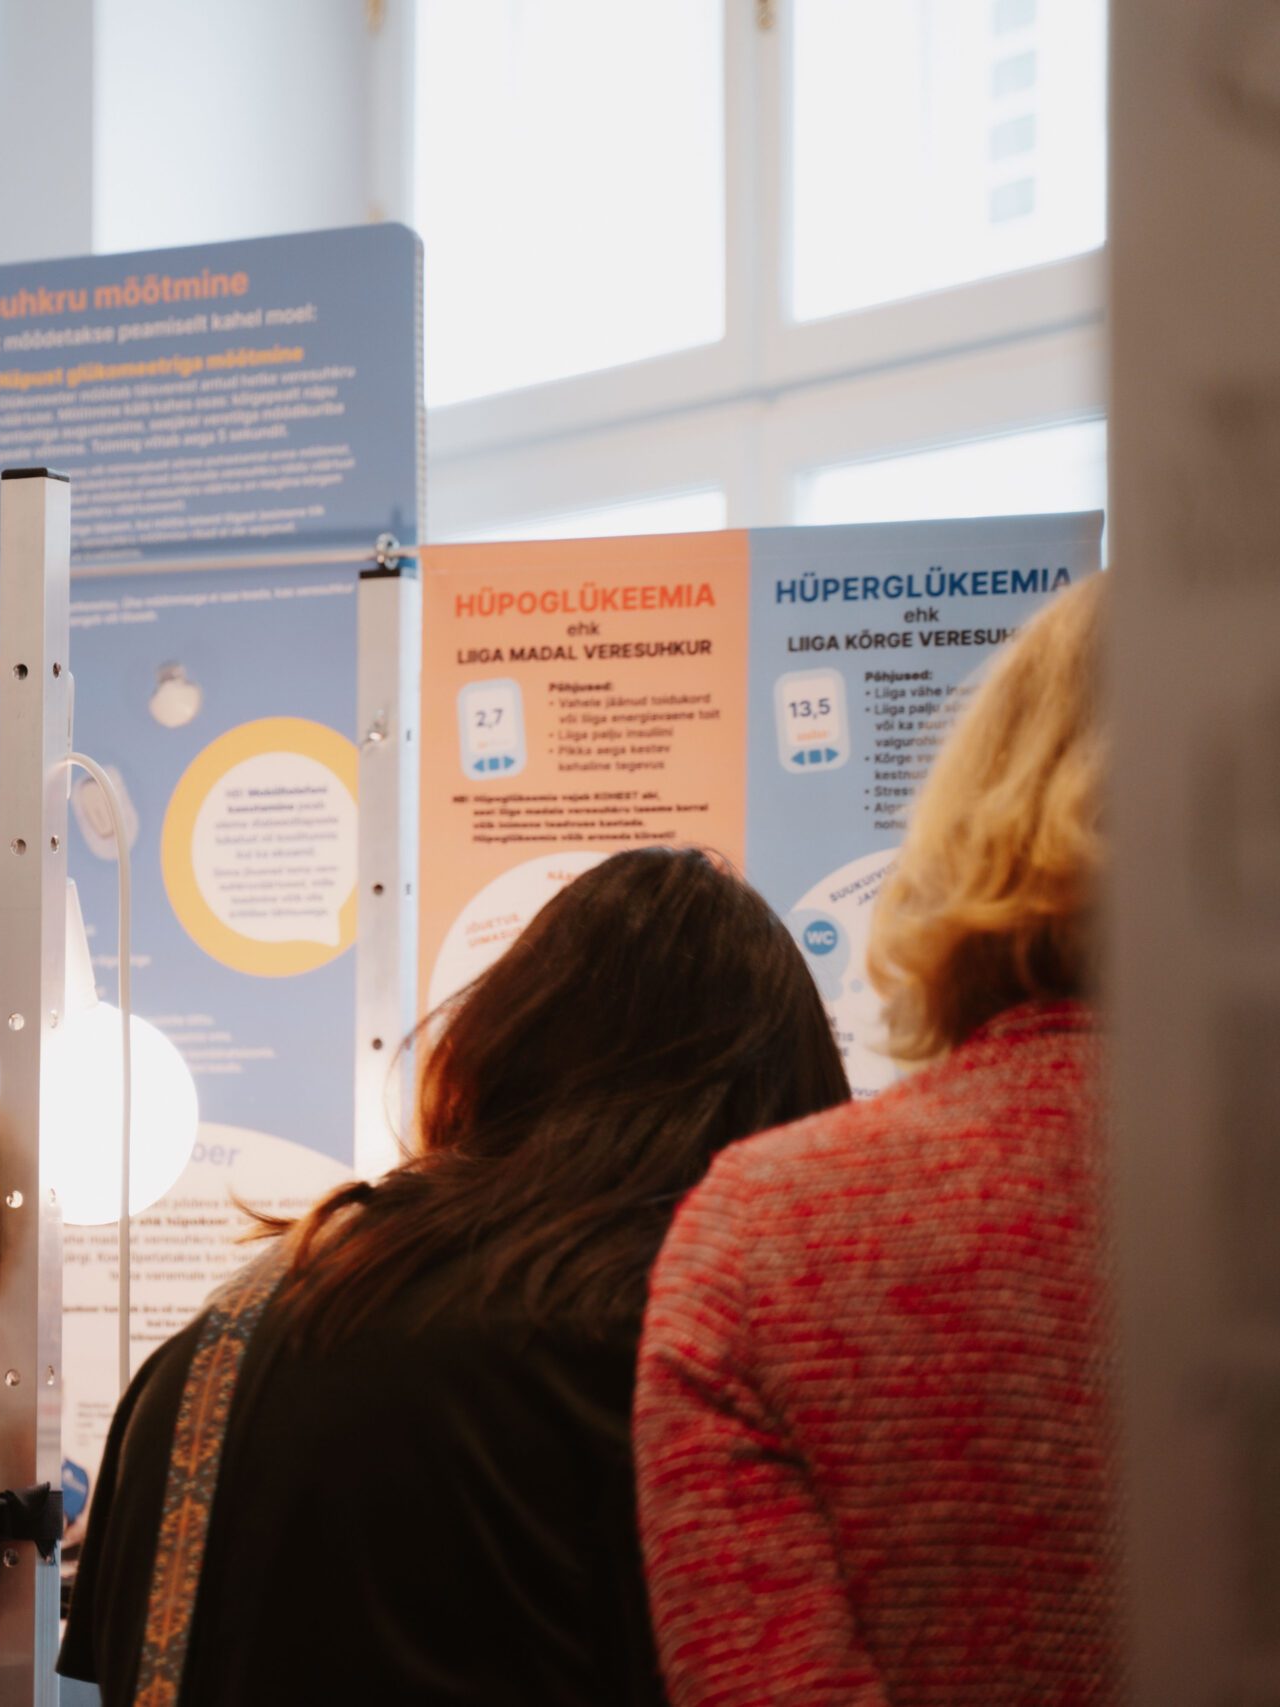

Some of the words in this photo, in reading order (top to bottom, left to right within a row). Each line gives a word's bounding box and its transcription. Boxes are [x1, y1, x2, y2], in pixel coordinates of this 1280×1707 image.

[94, 266, 249, 308] mõõtmine
[3, 326, 114, 350] mõõdetakse
[118, 315, 207, 344] peamiselt
[211, 308, 262, 332] kahel
[775, 566, 1071, 604] HÜPERGLÜKEEMIA
[454, 582, 716, 618] HÜPOGLÜKEEMIA
[903, 607, 940, 623] ehk
[566, 621, 600, 637] ehk
[787, 634, 840, 652] LIIGA
[845, 629, 912, 648] KÕRGE
[918, 628, 1020, 647] VERESUH
[457, 648, 504, 665] LIIGA
[510, 645, 577, 662] MADAL
[583, 639, 713, 659] VERESUHKUR
[865, 670, 933, 683] Põhjused:
[875, 687, 906, 699] Liiga
[910, 685, 942, 697] vähe
[475, 708, 504, 728] 2,7
[790, 697, 831, 719] 13,5
[875, 703, 905, 716] Liiga
[908, 702, 940, 715] palju
[876, 720, 894, 731] või
[807, 930, 834, 945] WC
